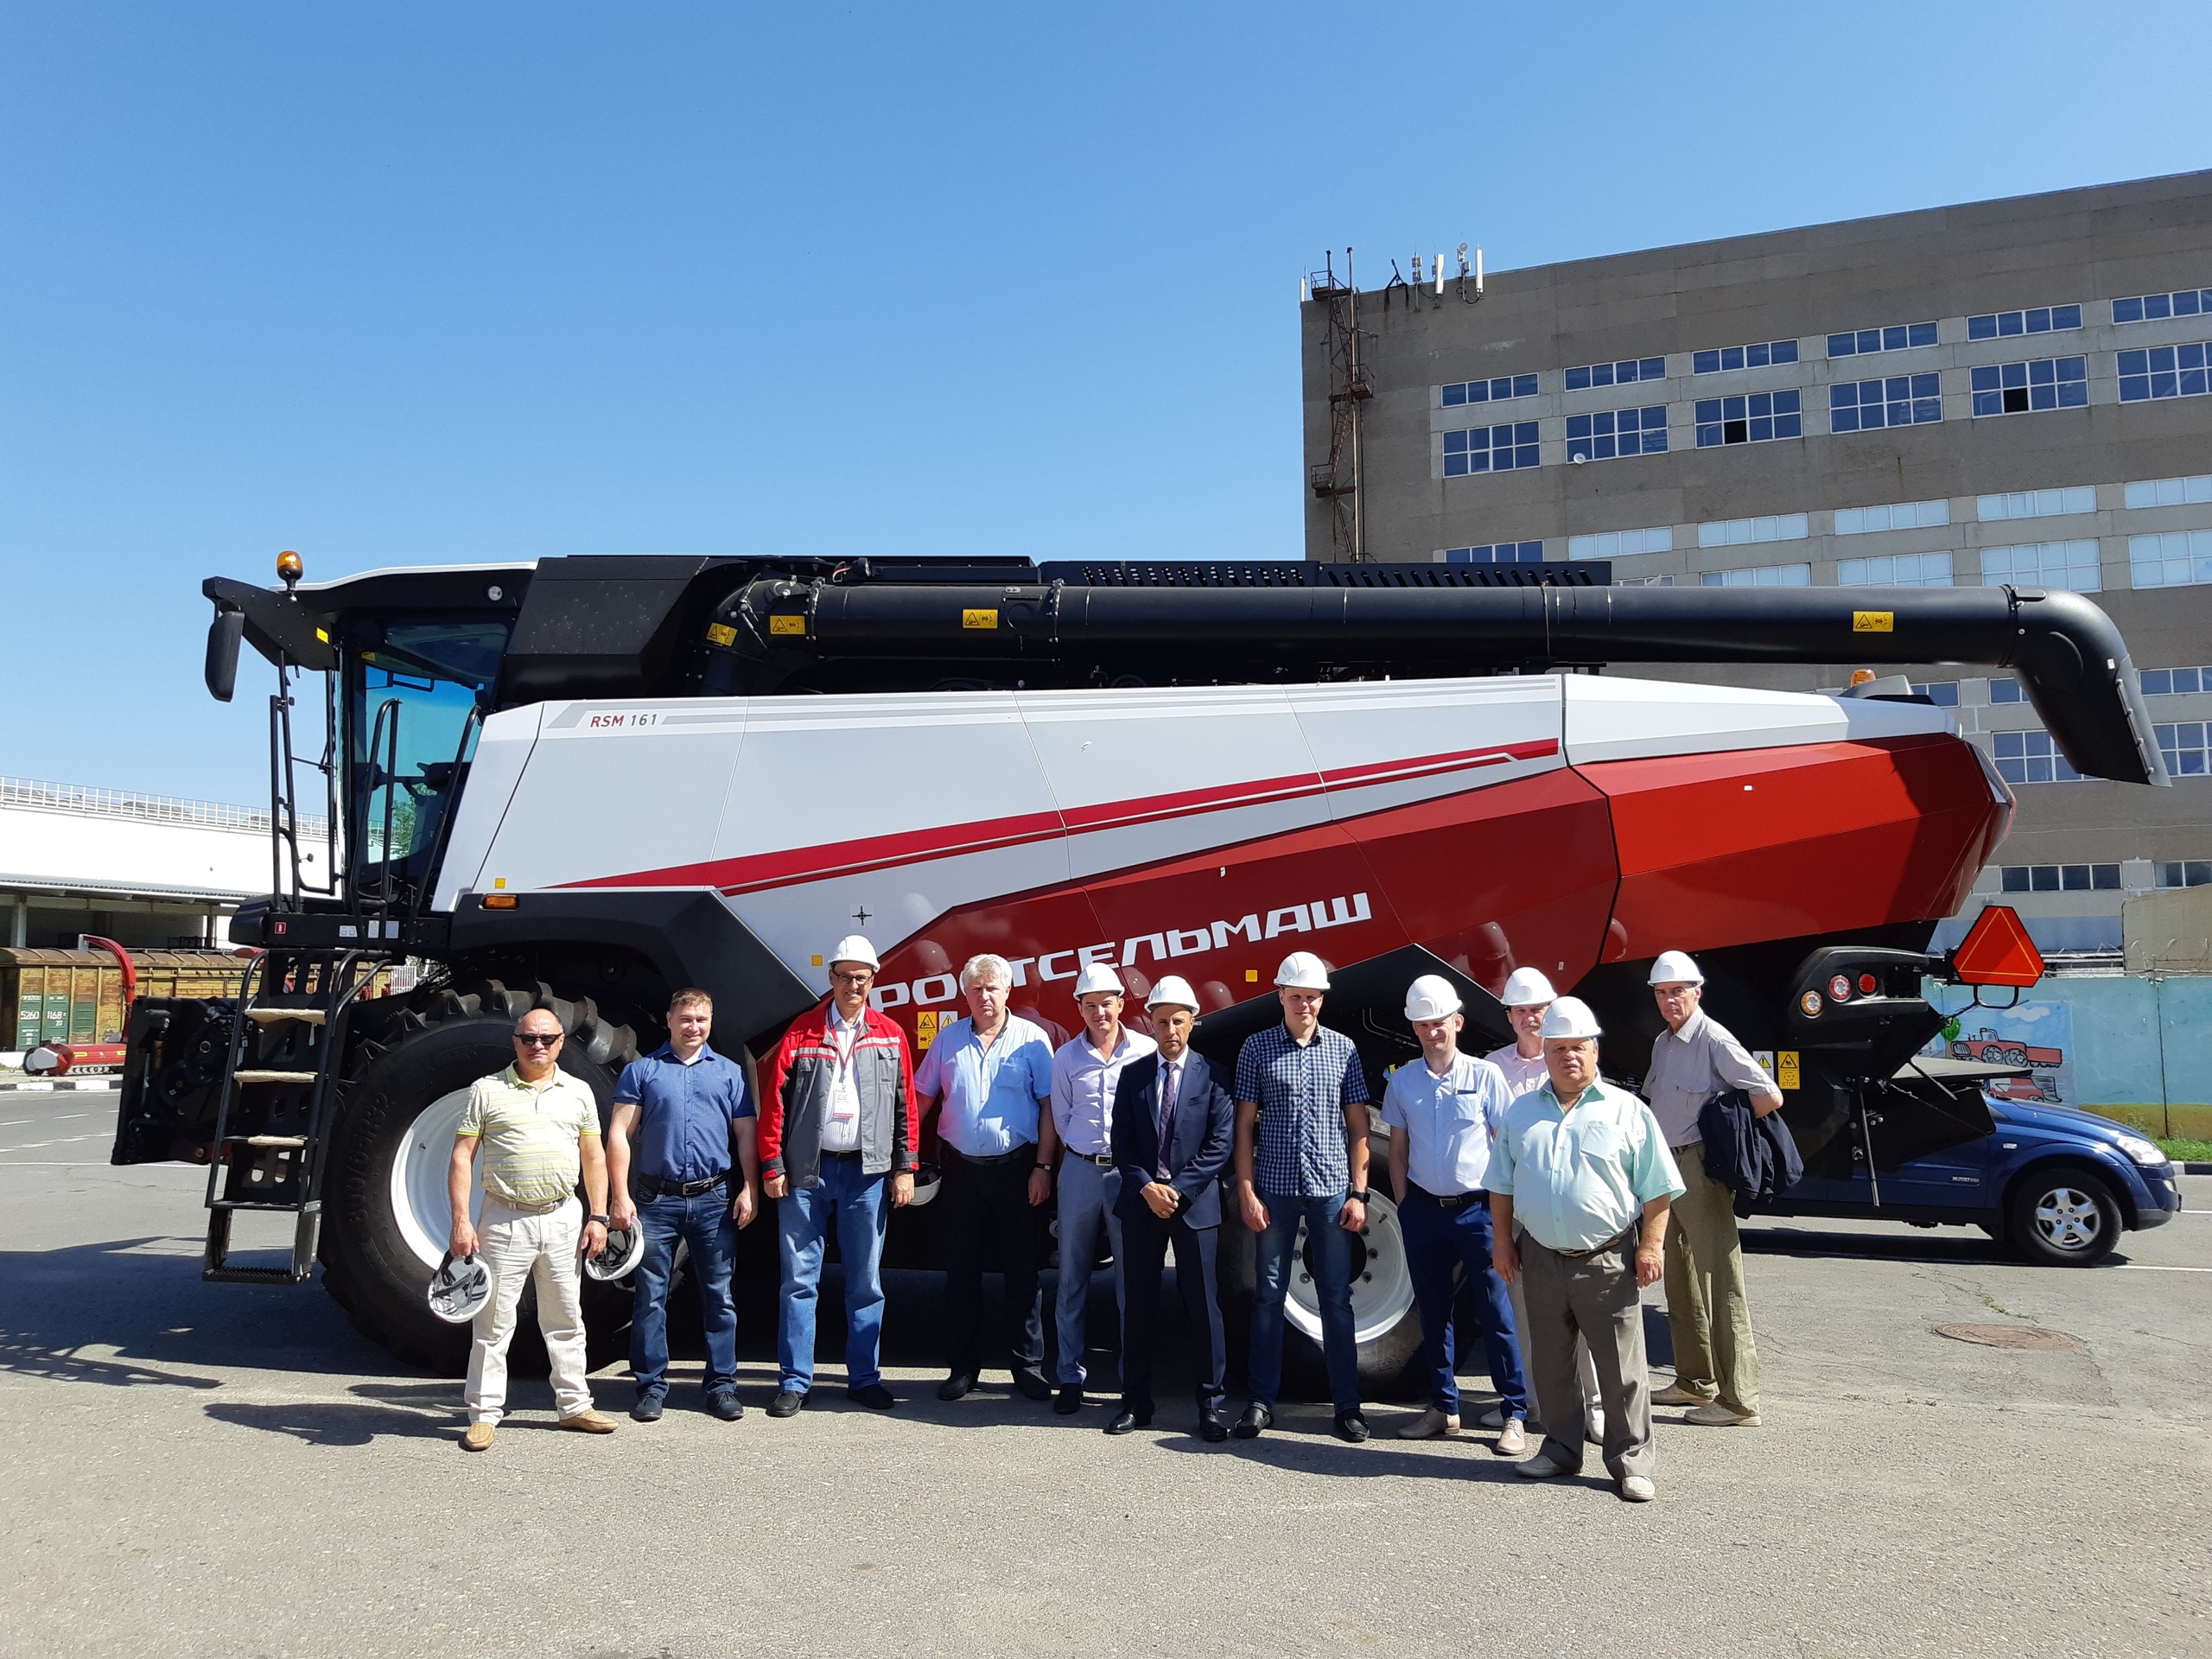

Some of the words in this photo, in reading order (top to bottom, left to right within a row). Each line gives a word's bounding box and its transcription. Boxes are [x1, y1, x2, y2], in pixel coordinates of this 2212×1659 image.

[589, 715, 625, 728] RSM
[630, 713, 658, 727] 161
[868, 891, 1373, 1013] РОТСЕЛЬМАШ
[20, 1010, 41, 1020] 5260
[47, 1010, 63, 1020] 1168
